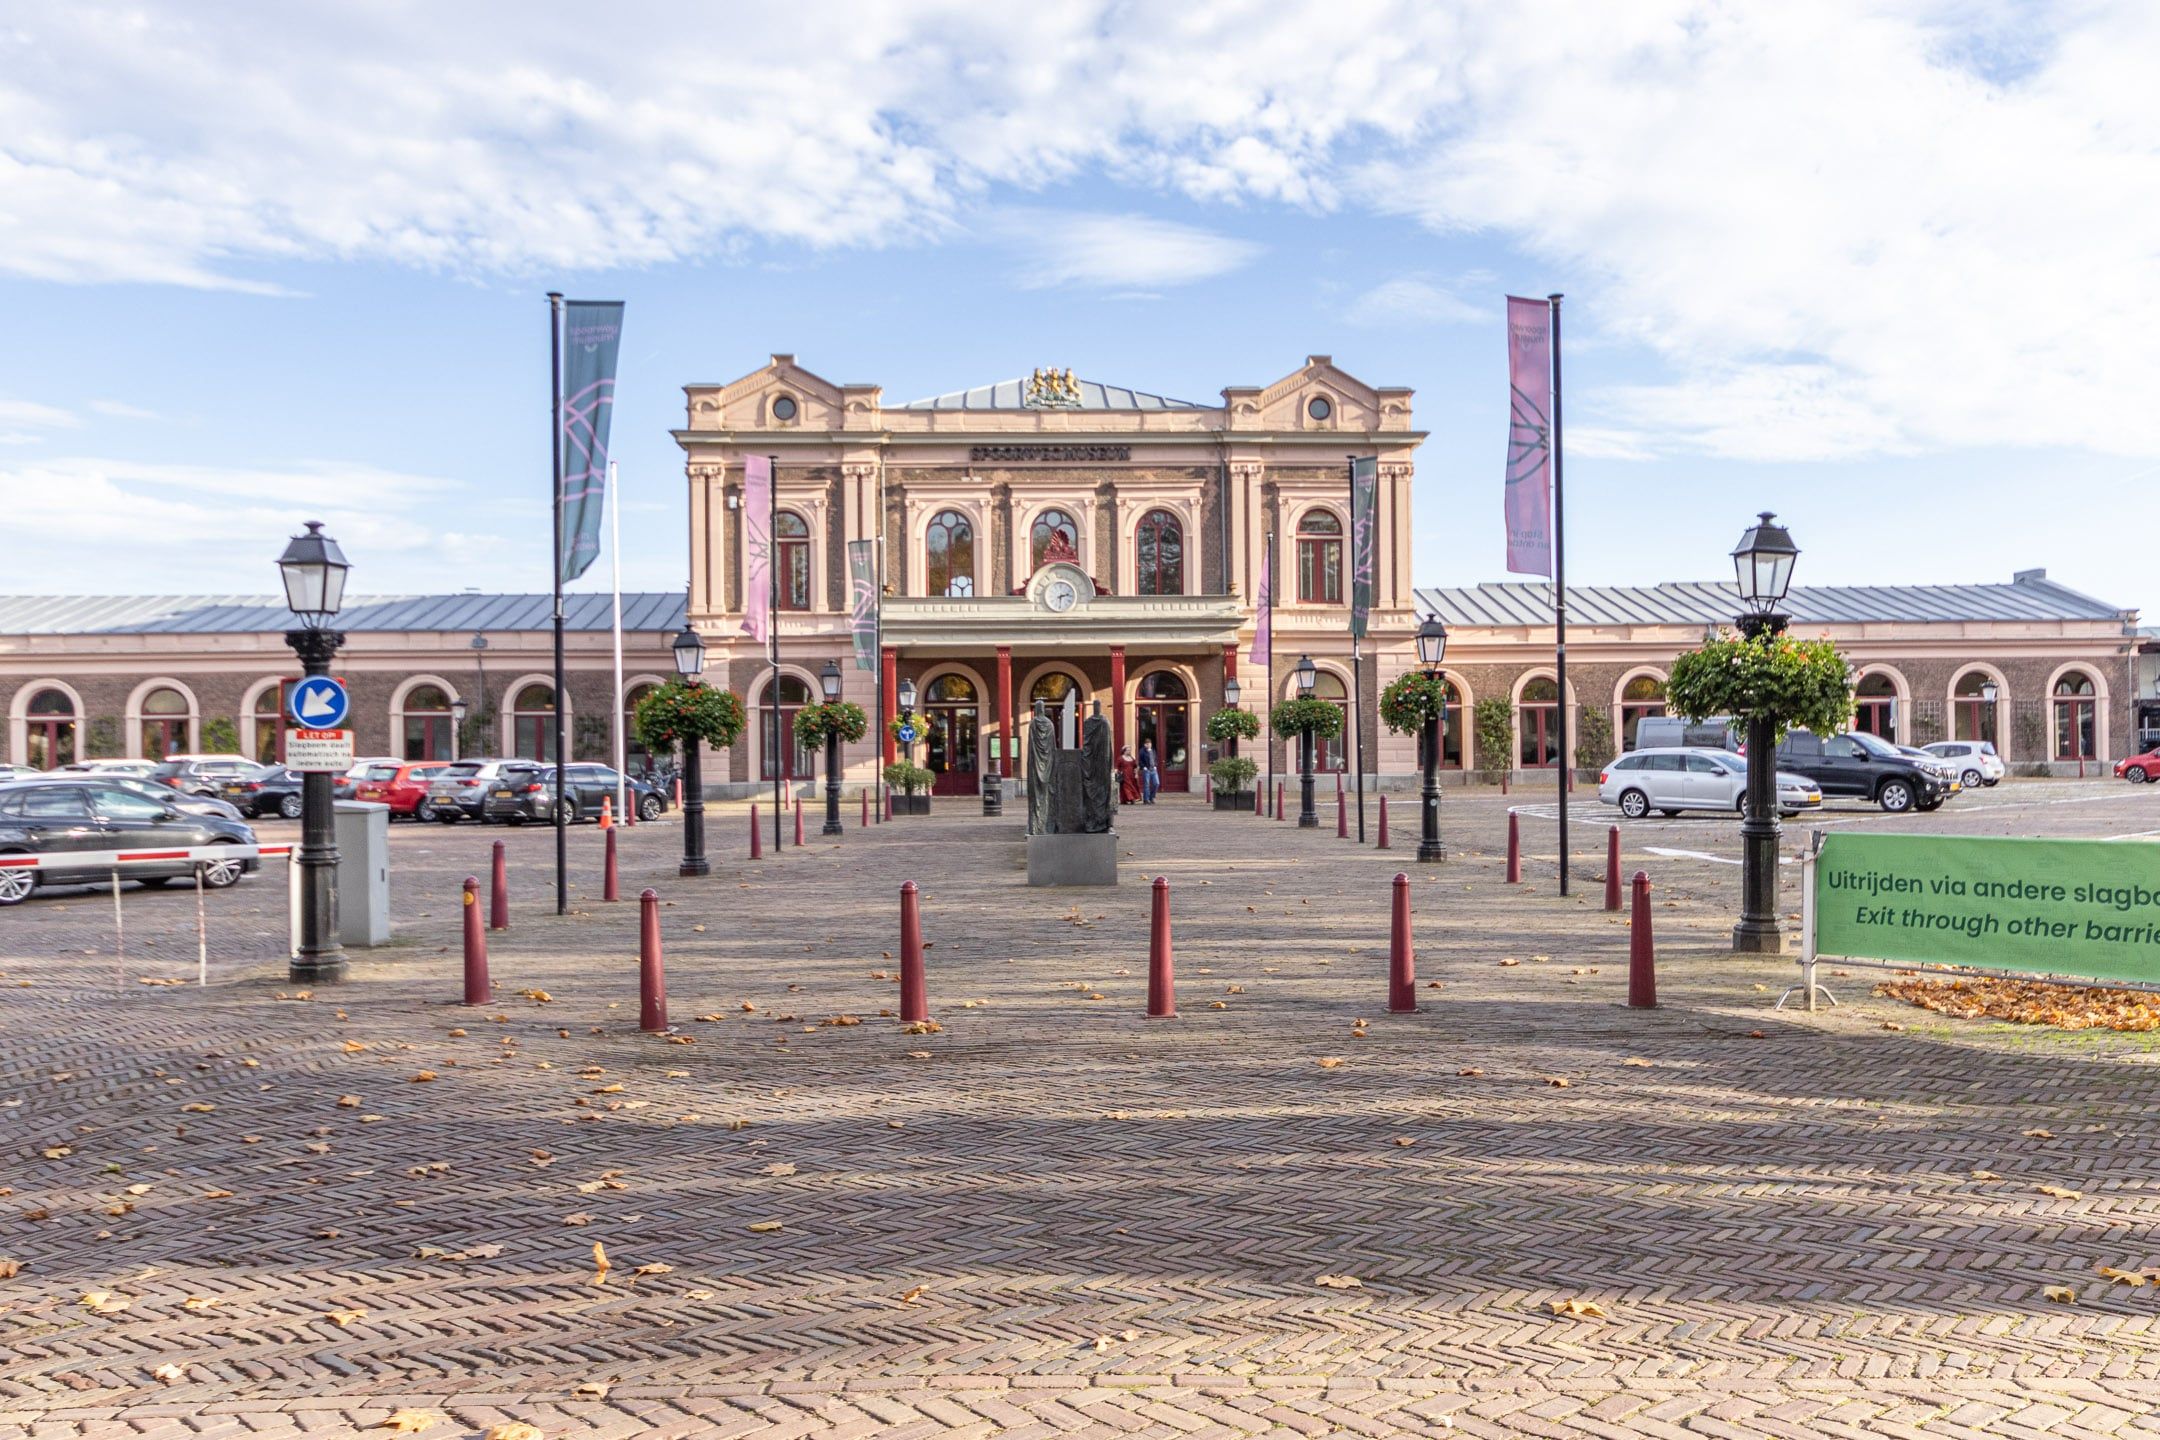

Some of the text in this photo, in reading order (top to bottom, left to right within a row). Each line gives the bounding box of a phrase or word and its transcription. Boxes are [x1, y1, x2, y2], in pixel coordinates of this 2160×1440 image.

[303, 731, 320, 739] LET
[1828, 870, 1923, 897] Uitrijden
[1930, 874, 1966, 896] via
[1973, 879, 2067, 901] andere
[1856, 906, 1896, 926] Exit
[1902, 908, 1999, 938] through
[2007, 916, 2079, 938] other
